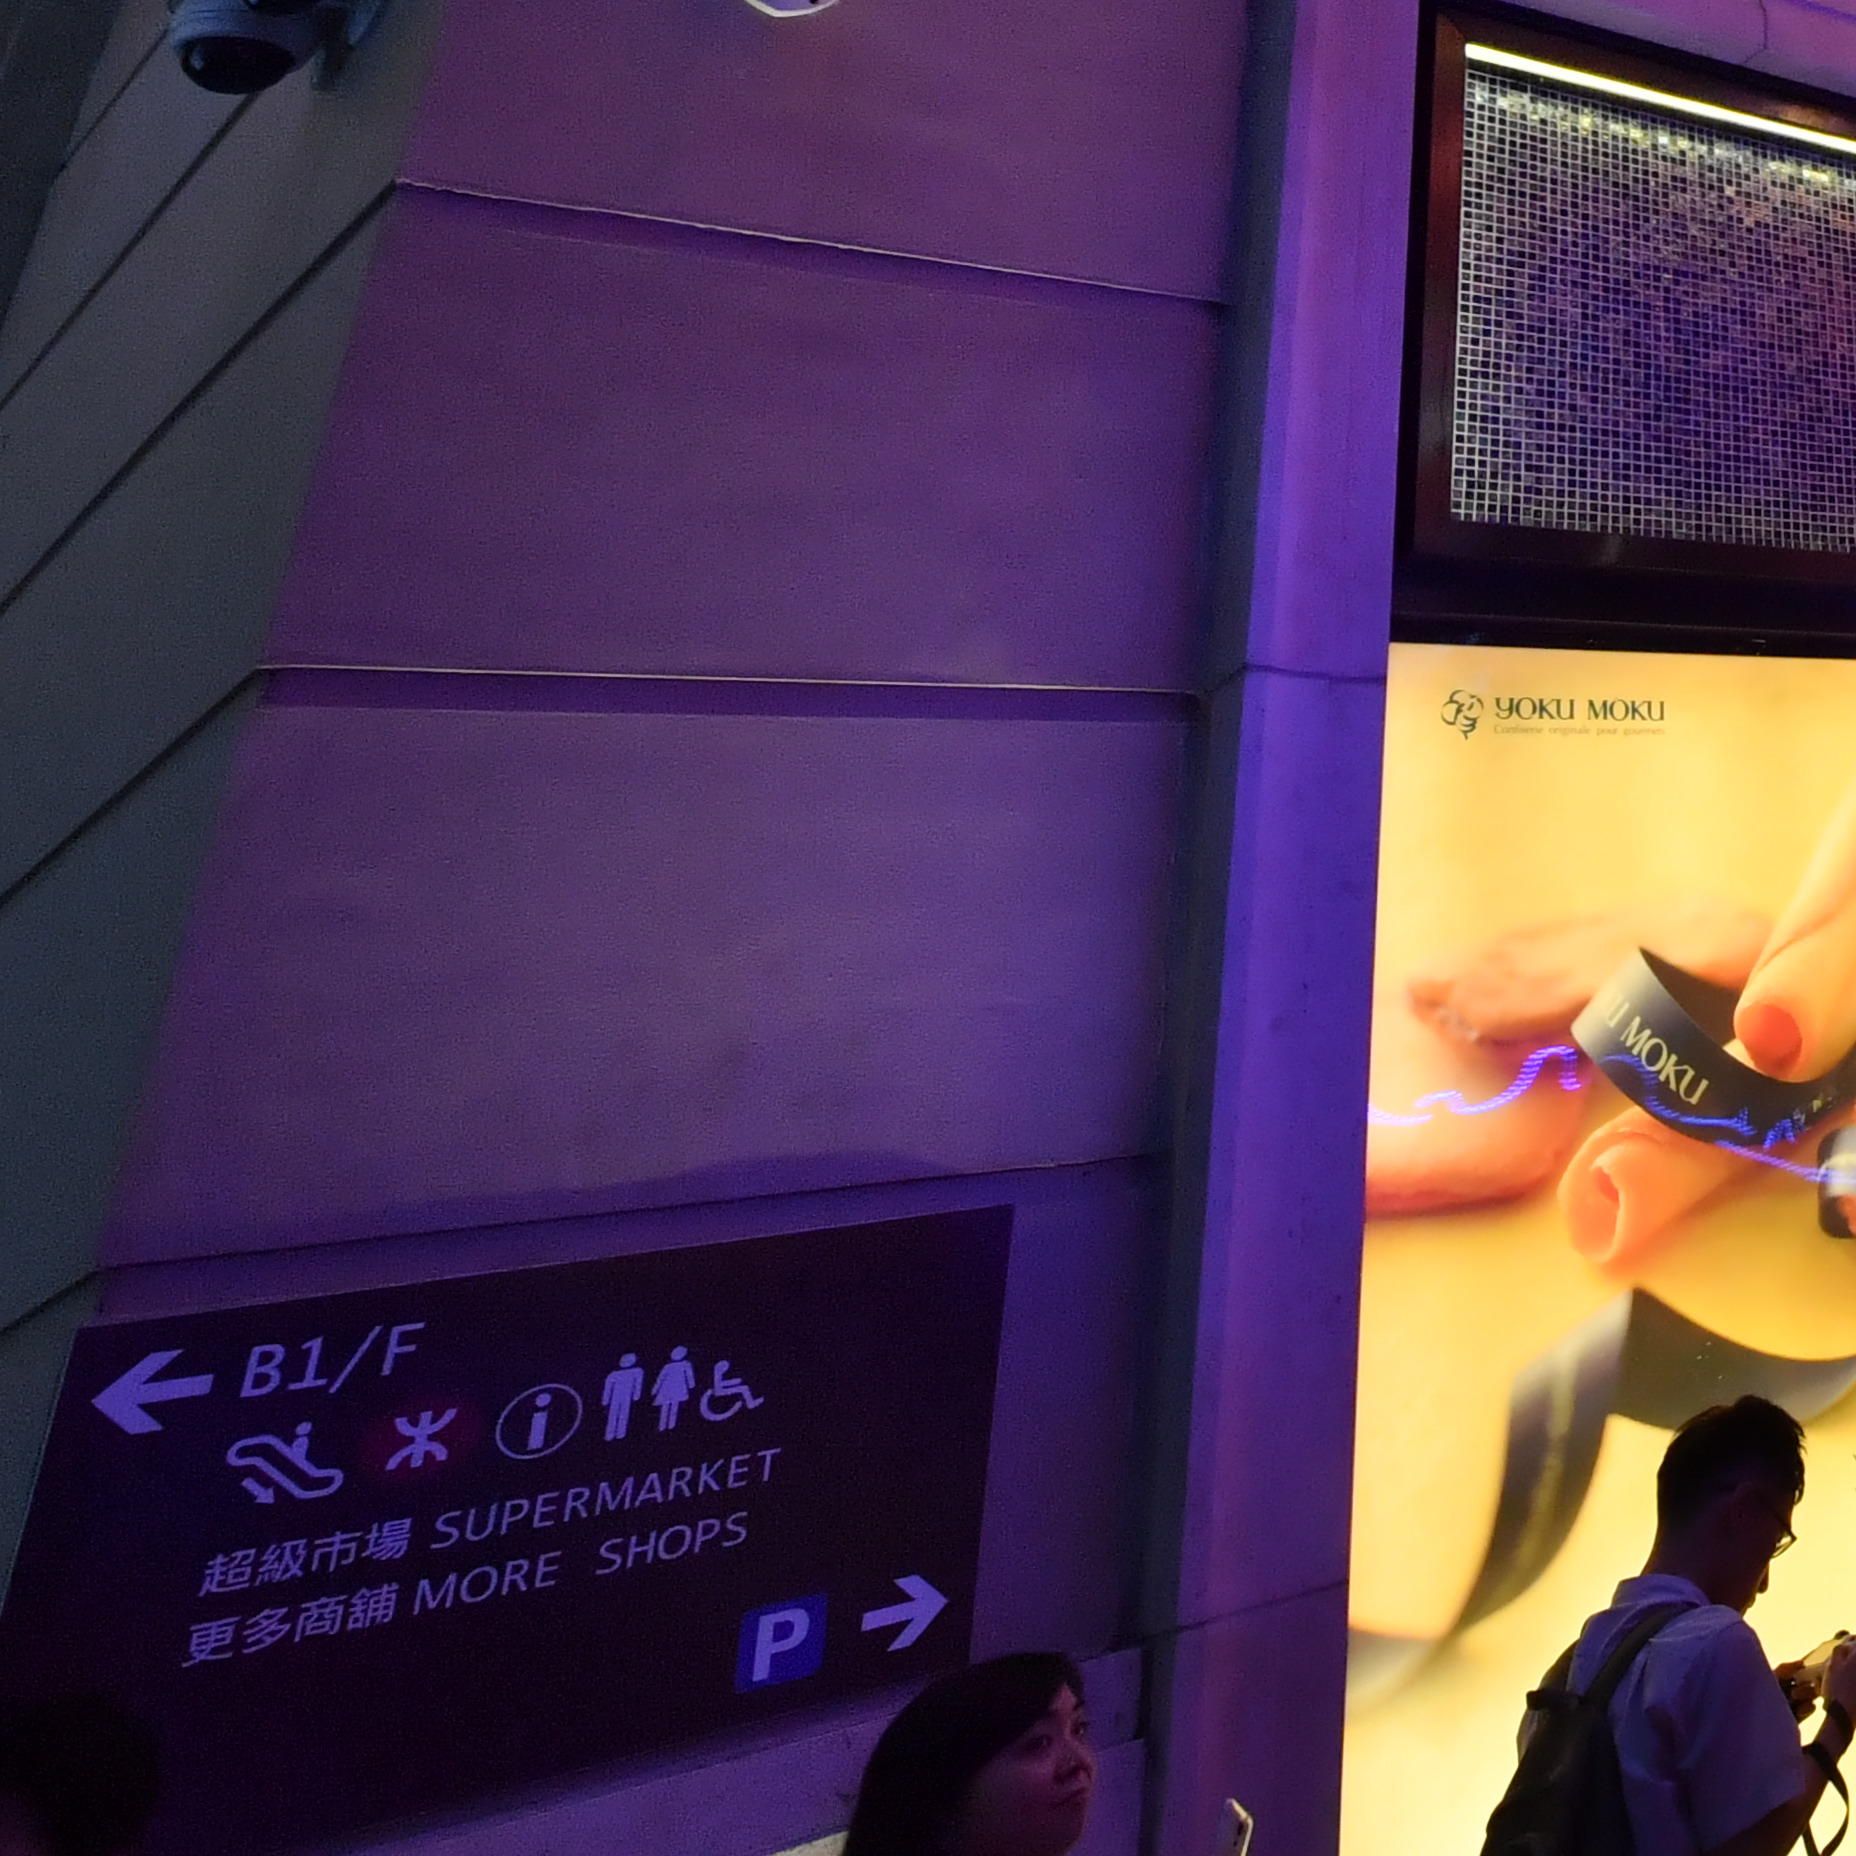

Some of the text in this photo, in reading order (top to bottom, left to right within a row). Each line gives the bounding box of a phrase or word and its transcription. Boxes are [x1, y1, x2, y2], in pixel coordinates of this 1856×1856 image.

[1494, 696, 1665, 721] YOKU MOKU
[1619, 1015, 1710, 1105] MOKU
[239, 1322, 426, 1399] B1/F
[198, 1447, 782, 1598] 超級市場 SUPERMARKET
[413, 1550, 564, 1616] MORE
[594, 1511, 750, 1576] SHOPS
[751, 1607, 811, 1684] P
